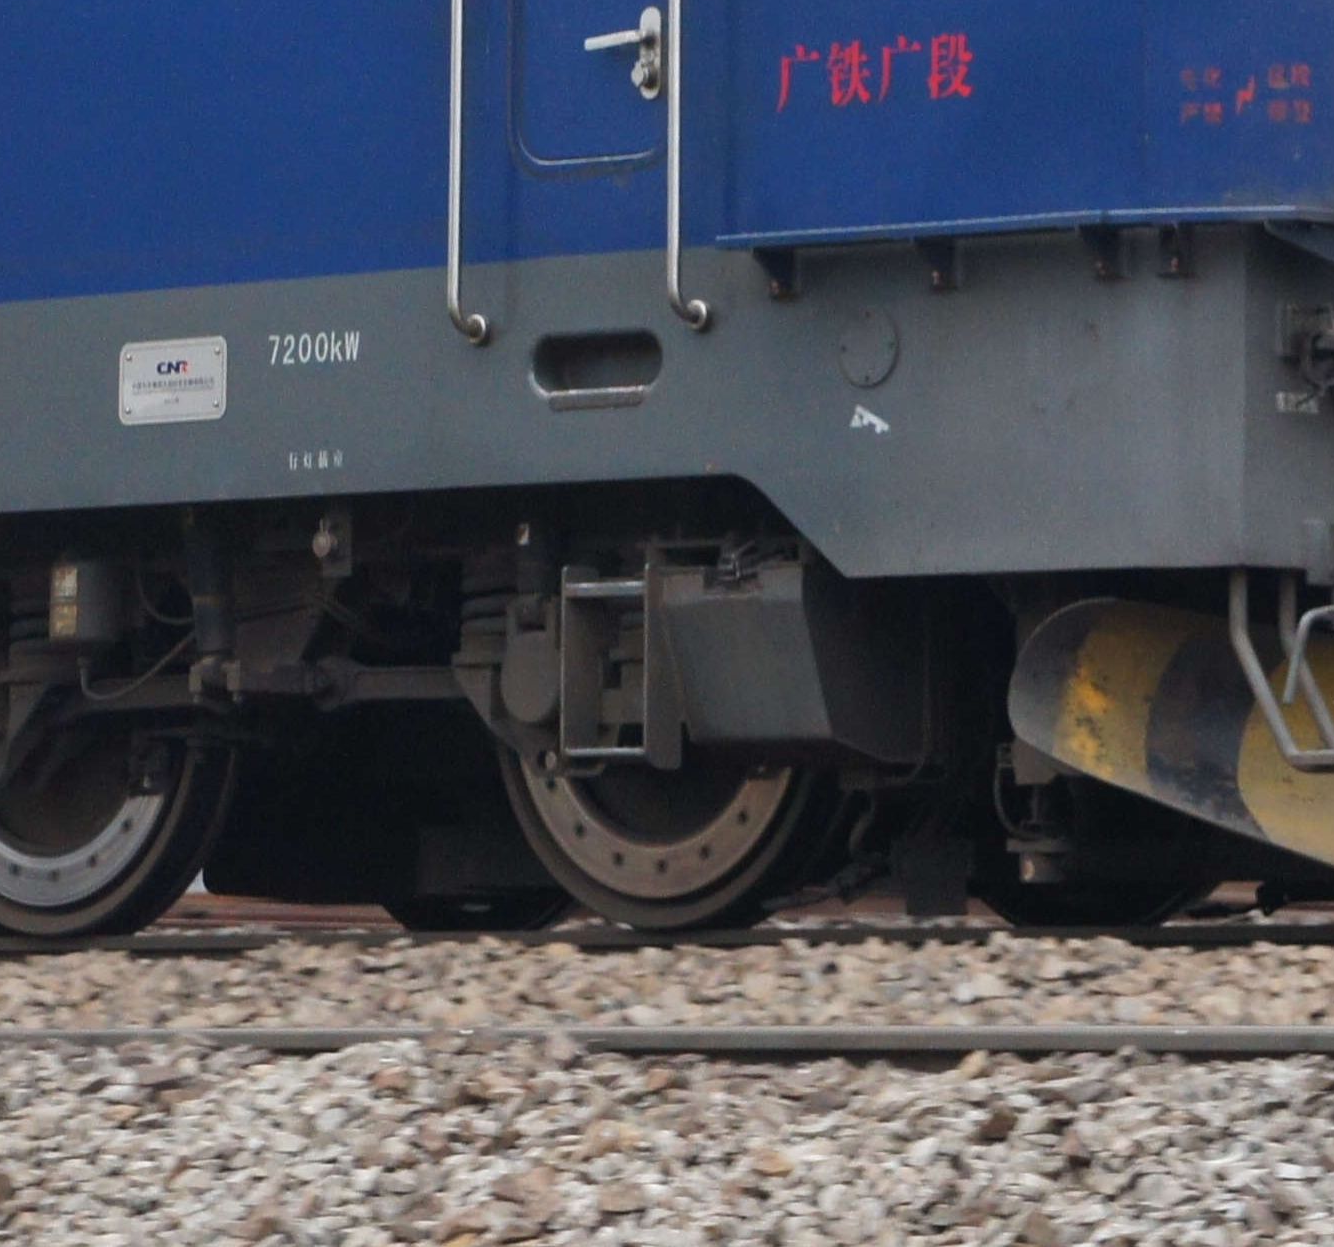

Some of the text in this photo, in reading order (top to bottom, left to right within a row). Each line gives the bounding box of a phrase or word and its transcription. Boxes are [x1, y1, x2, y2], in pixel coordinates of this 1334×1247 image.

[775, 32, 974, 112] 广铁广段
[268, 330, 360, 365] 7200kW
